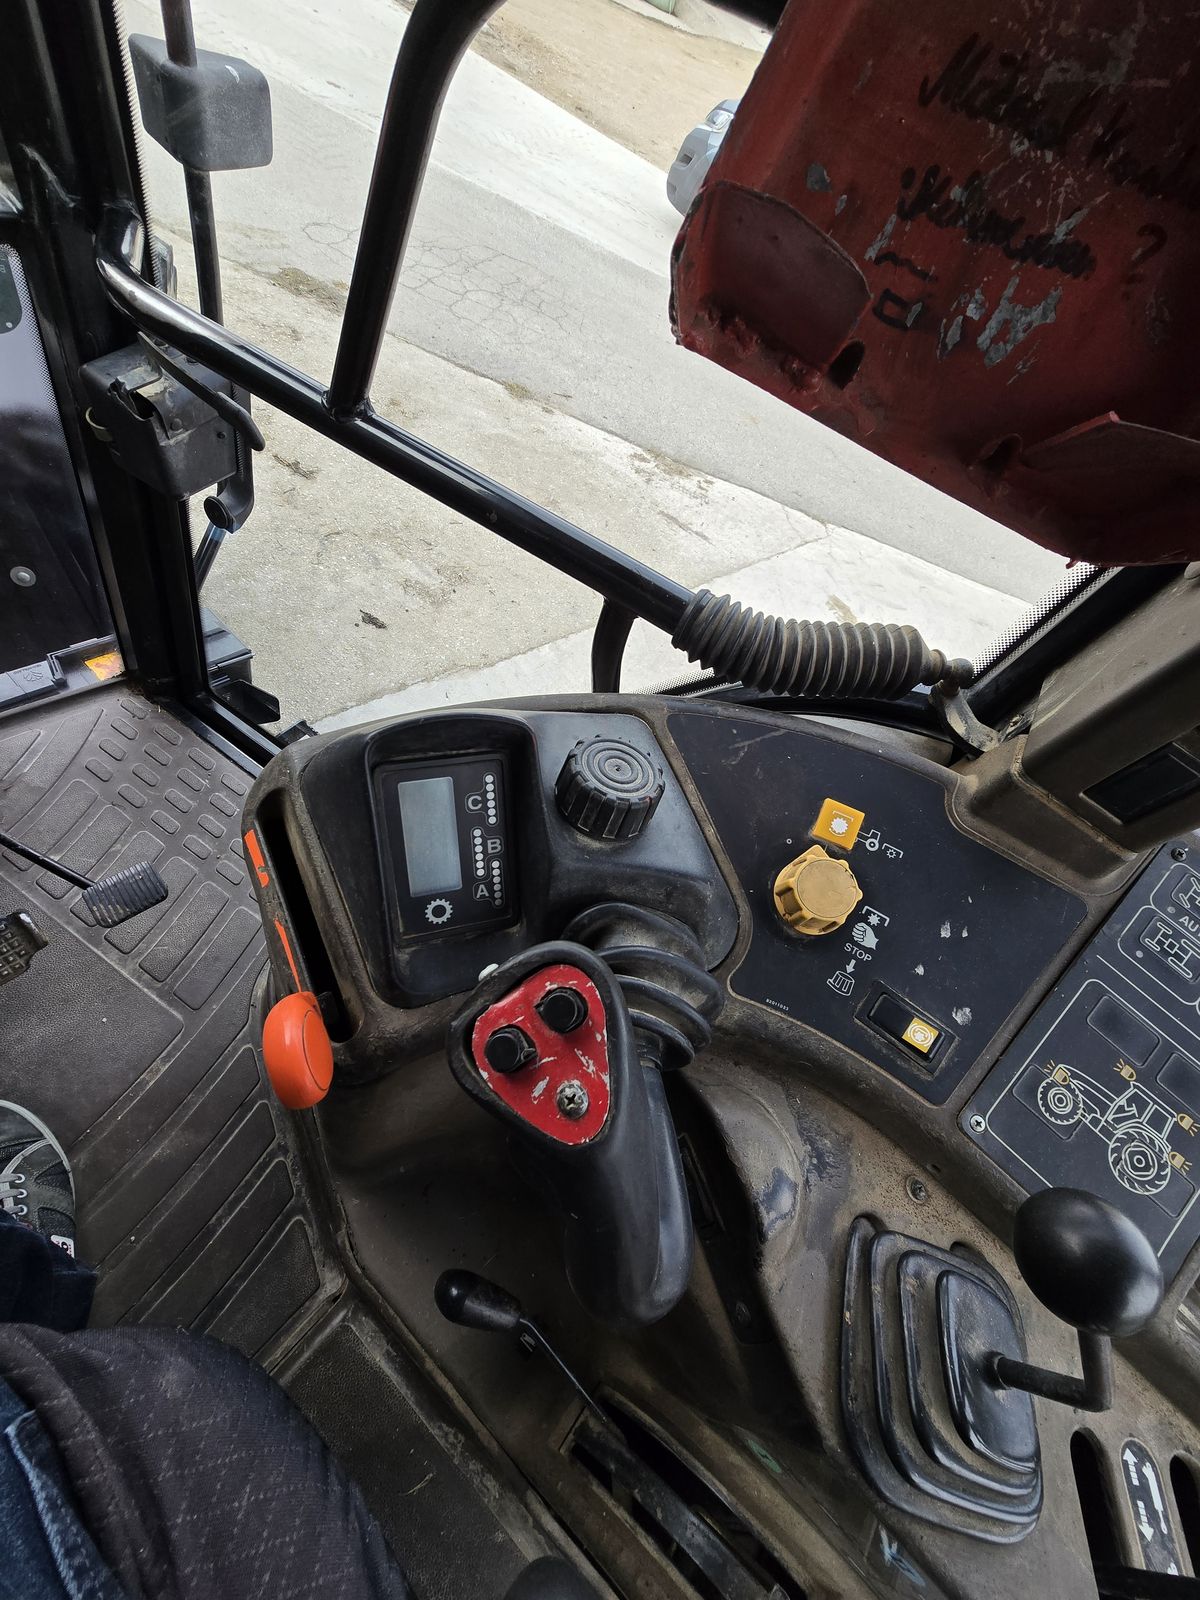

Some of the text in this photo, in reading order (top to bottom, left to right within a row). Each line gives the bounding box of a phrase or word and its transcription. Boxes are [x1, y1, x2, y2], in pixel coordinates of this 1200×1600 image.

[468, 796, 483, 810] C
[487, 839, 502, 854] B
[476, 884, 489, 898] A
[1179, 915, 1200, 936] AU
[844, 943, 872, 961] STOP
